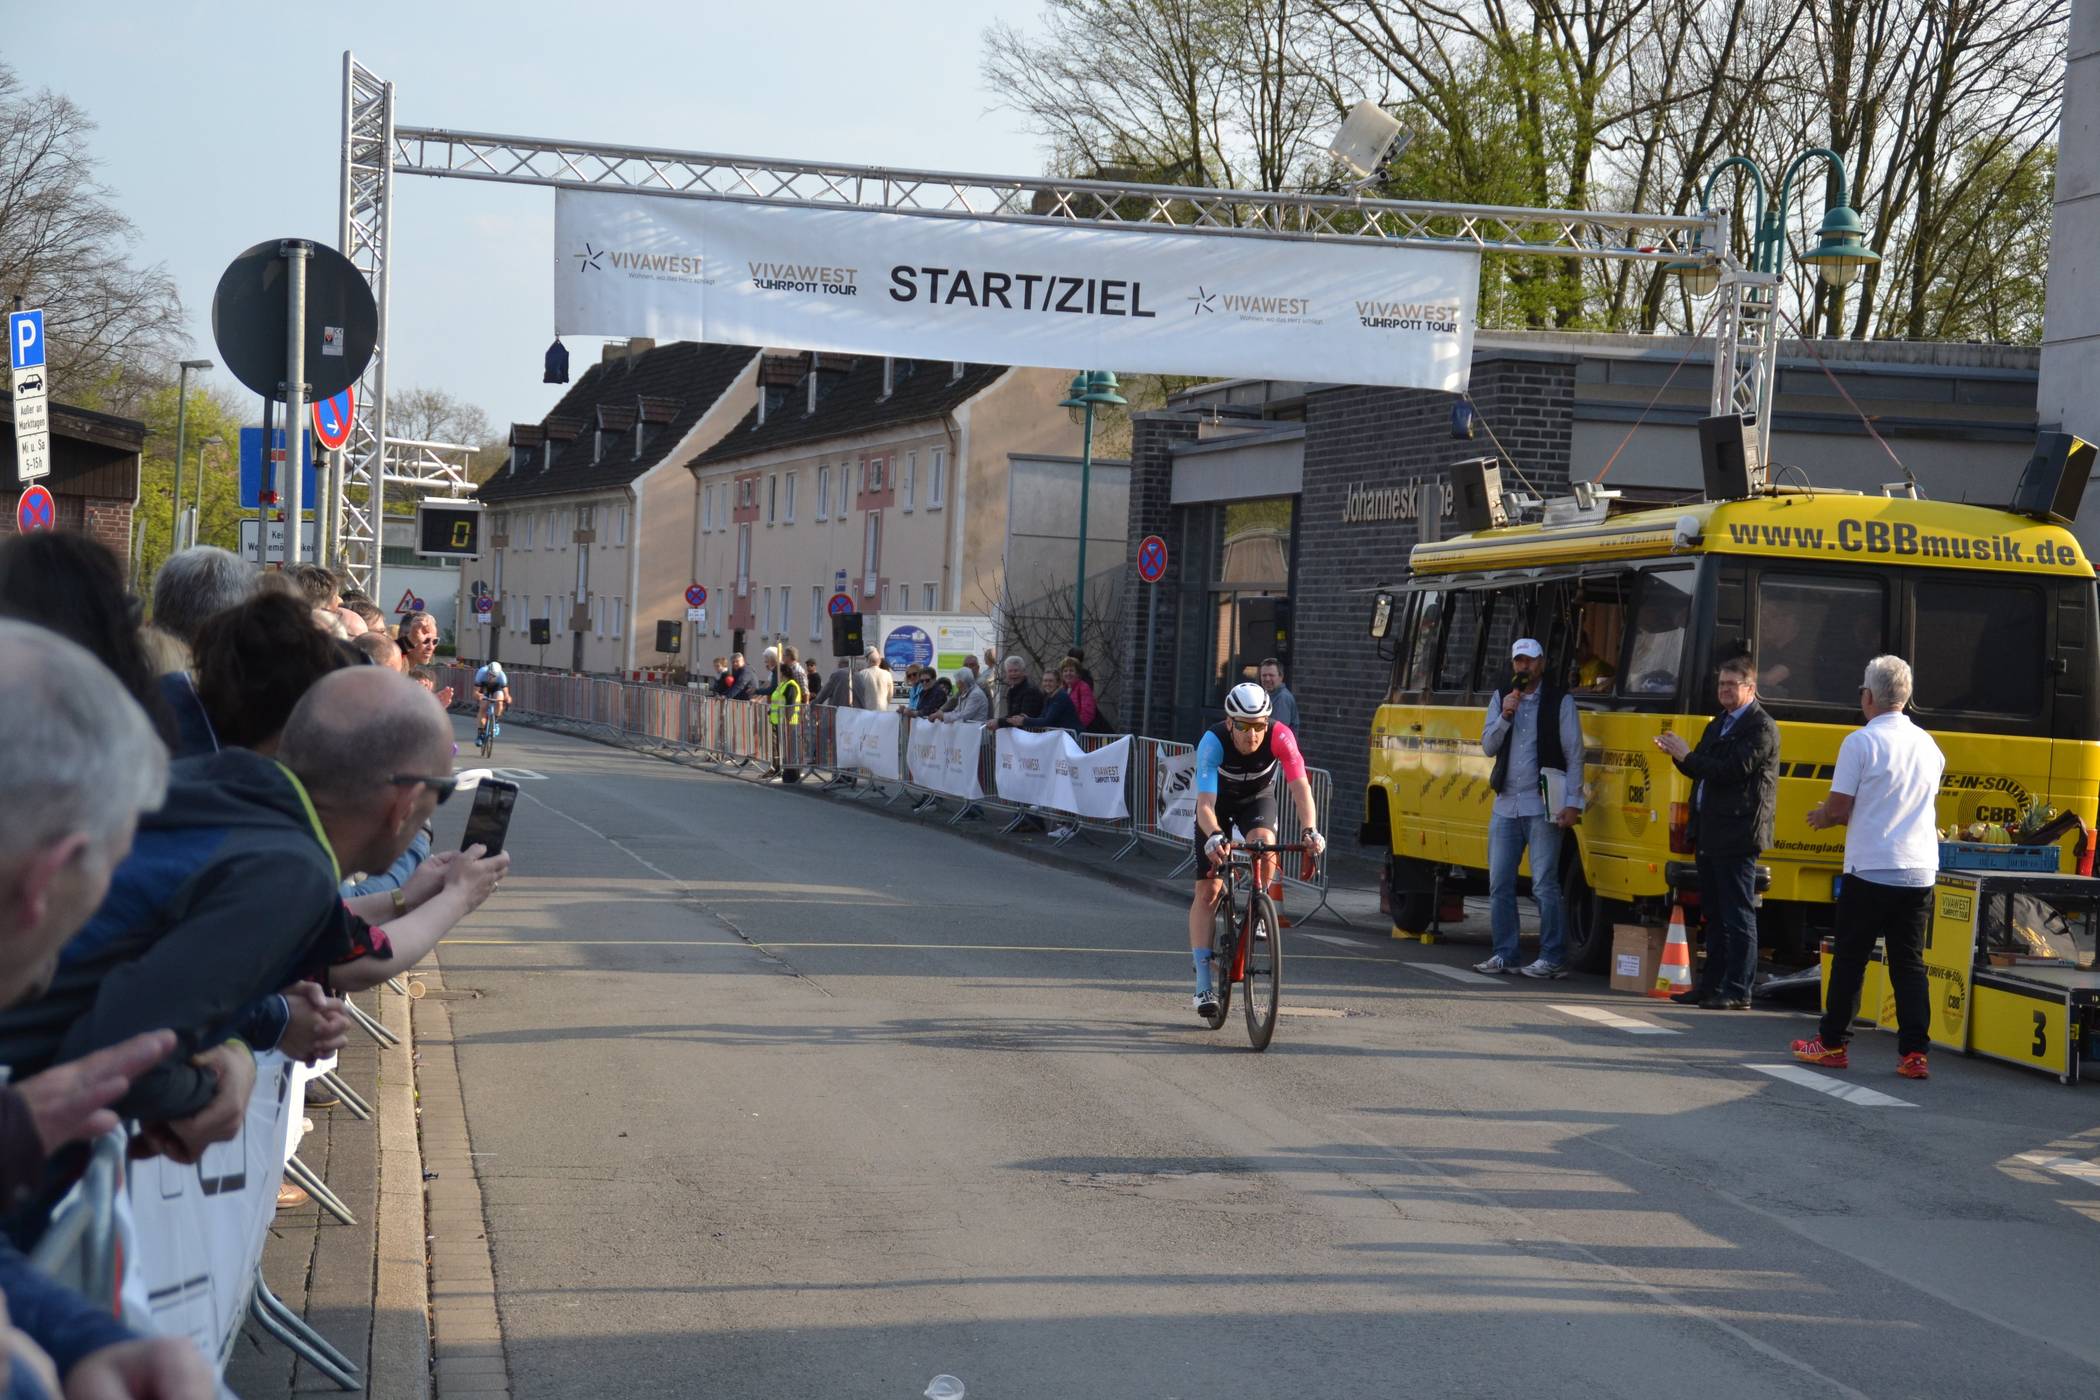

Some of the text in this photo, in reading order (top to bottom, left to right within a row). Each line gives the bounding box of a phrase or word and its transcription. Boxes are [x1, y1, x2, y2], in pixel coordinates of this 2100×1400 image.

[611, 252, 703, 274] VIVAWEST
[748, 262, 858, 285] VIVAWEST
[753, 278, 857, 296] RUHRPOTT TOUR
[889, 265, 1157, 318] START/ZIEL
[1223, 295, 1310, 315] VIVAWEST
[1355, 301, 1459, 321] VIVAWEST
[1360, 316, 1458, 333] RUHRPOTT TOUR
[18, 319, 36, 365] P
[19, 418, 46, 431] Markttagen
[22, 441, 30, 454] Mi
[38, 438, 46, 451] Sa
[451, 521, 470, 548] 0
[1729, 519, 2077, 567] www.CBBmusik.de
[1629, 785, 1644, 803] CBB
[1976, 805, 2016, 824] CBB
[1948, 994, 1960, 1010] CBB
[2032, 1009, 2047, 1058] 3
